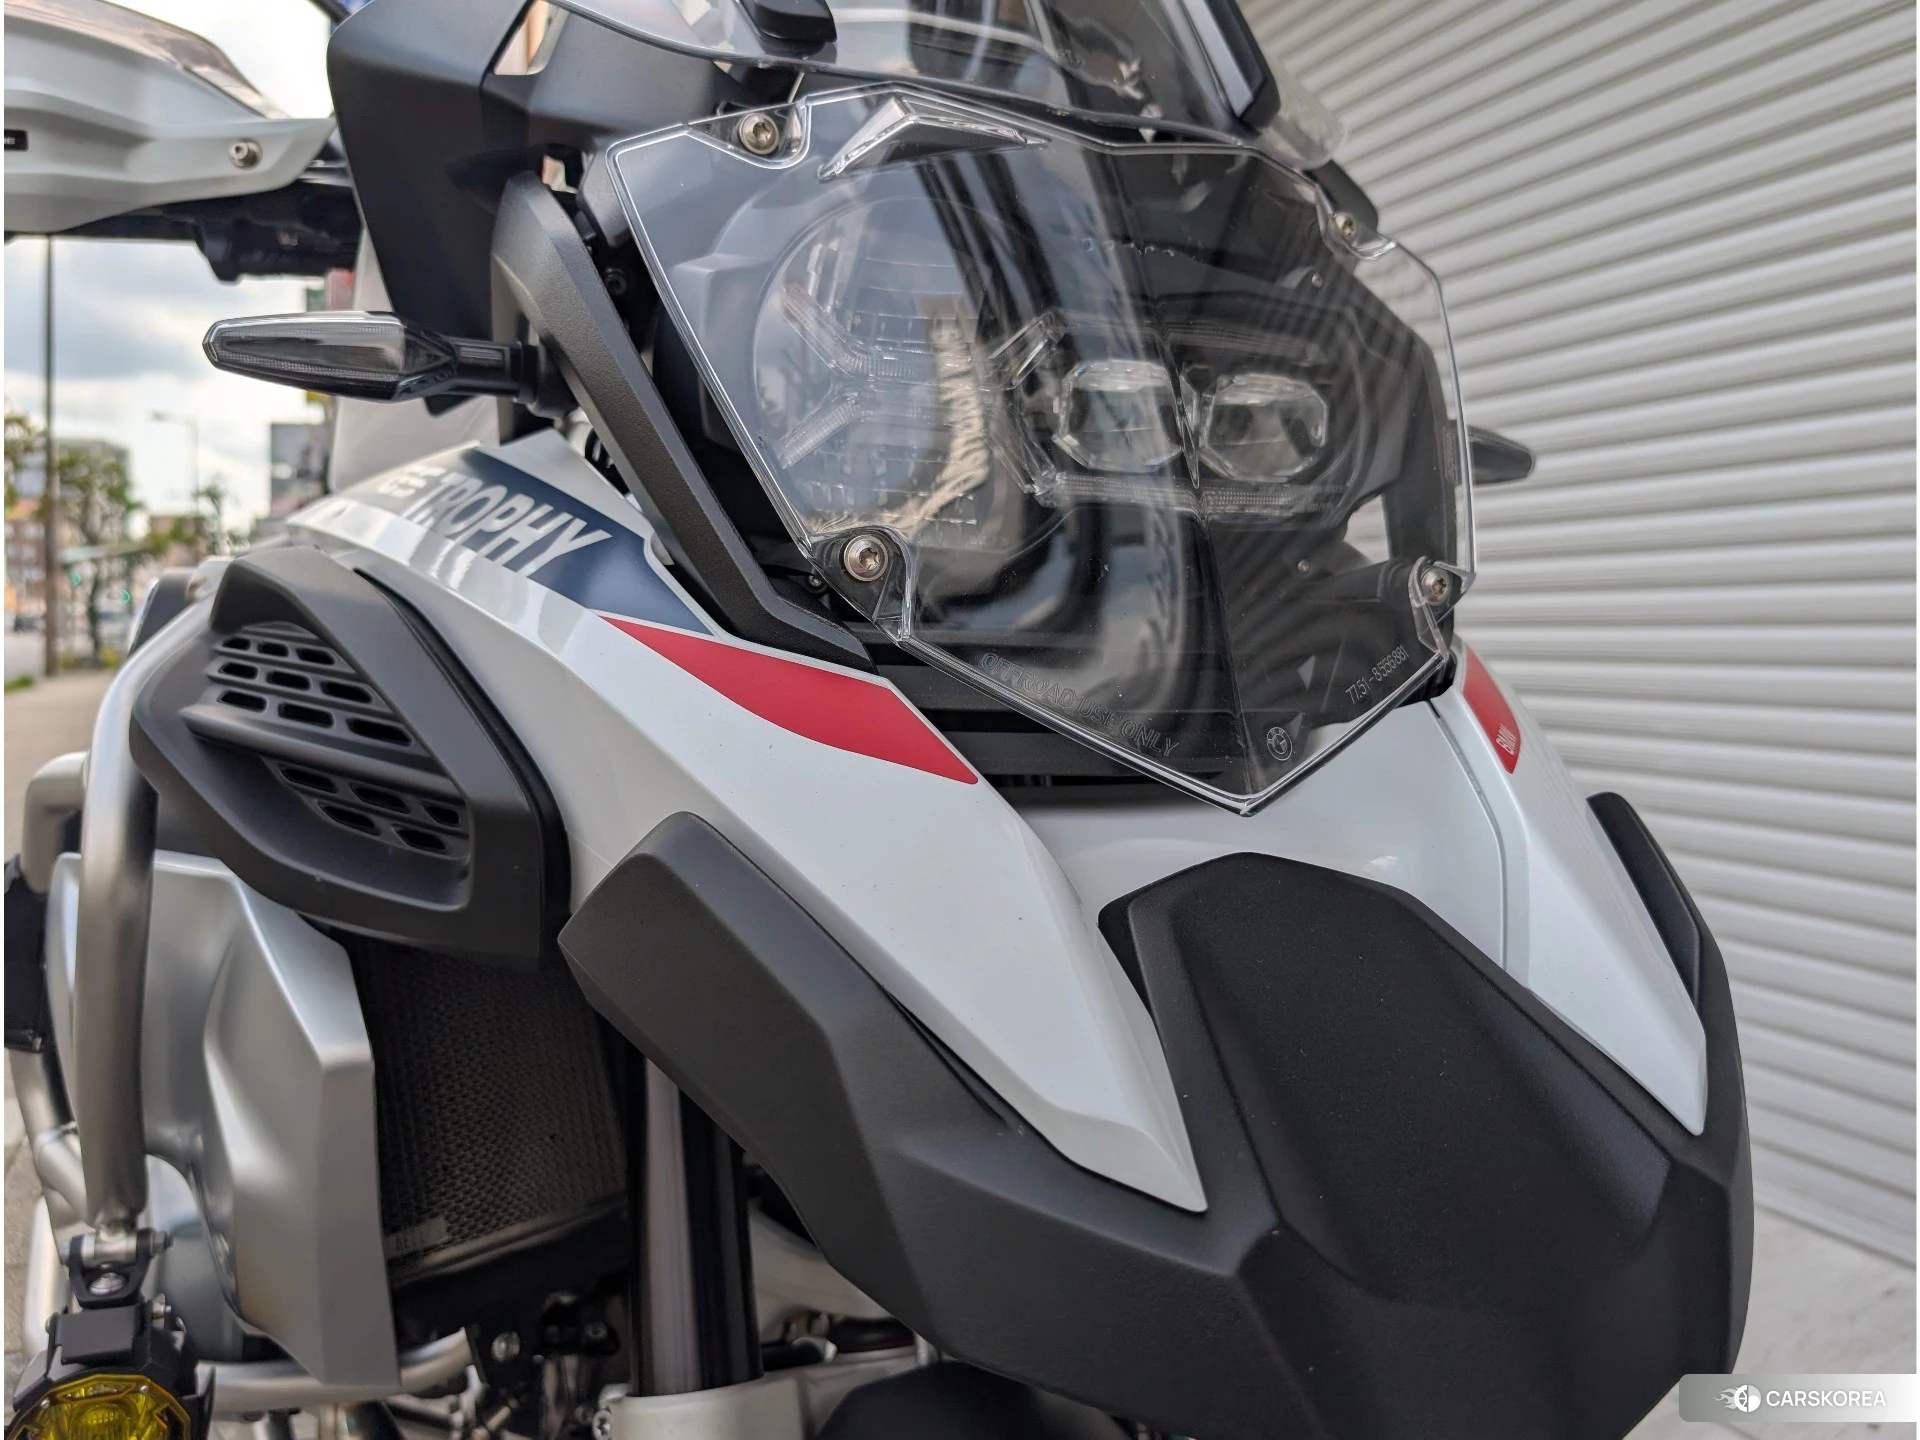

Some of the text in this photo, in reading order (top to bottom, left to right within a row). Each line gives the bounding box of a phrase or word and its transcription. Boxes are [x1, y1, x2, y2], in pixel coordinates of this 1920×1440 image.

[402, 472, 613, 578] TROPHY
[1077, 697, 1121, 730] USE
[1121, 719, 1180, 757] ONLY
[1496, 723, 1517, 755] BMW
